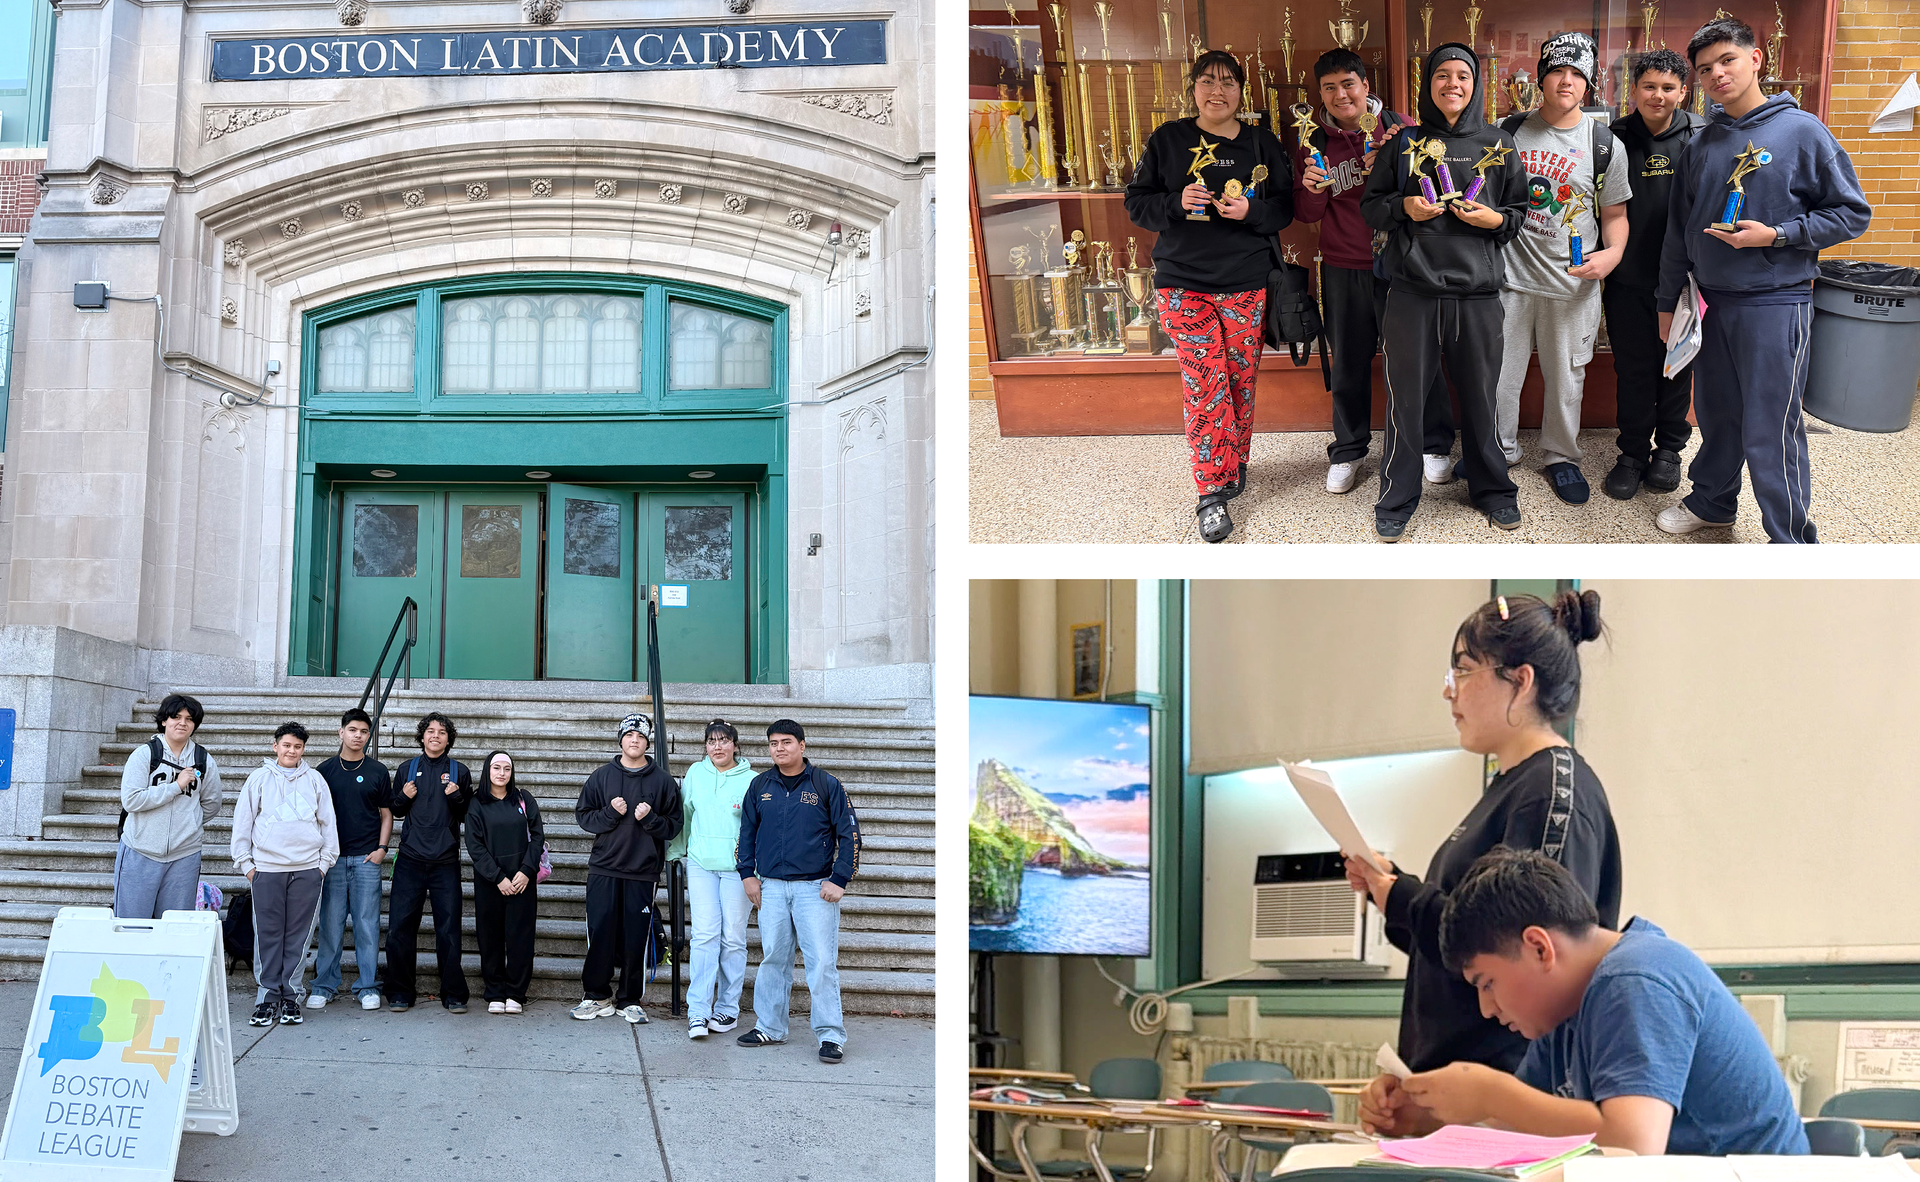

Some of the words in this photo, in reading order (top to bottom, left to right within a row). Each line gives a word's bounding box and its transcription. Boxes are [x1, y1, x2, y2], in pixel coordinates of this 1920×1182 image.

[250, 39, 422, 74] BOSTON
[440, 35, 583, 71] LATIN
[601, 28, 846, 66] ACADEMY
[1520, 150, 1577, 174] REVERE
[1641, 169, 1675, 177] SUBARU
[1329, 157, 1365, 197] BOS
[1527, 210, 1546, 224] VERE
[1522, 224, 1540, 233] HOME
[1540, 228, 1558, 238] BASE
[1853, 293, 1905, 307] BRUTE
[51, 1074, 150, 1100] BOSTON
[45, 1101, 145, 1129] DEBATE
[38, 1131, 138, 1159] LEAGUE
